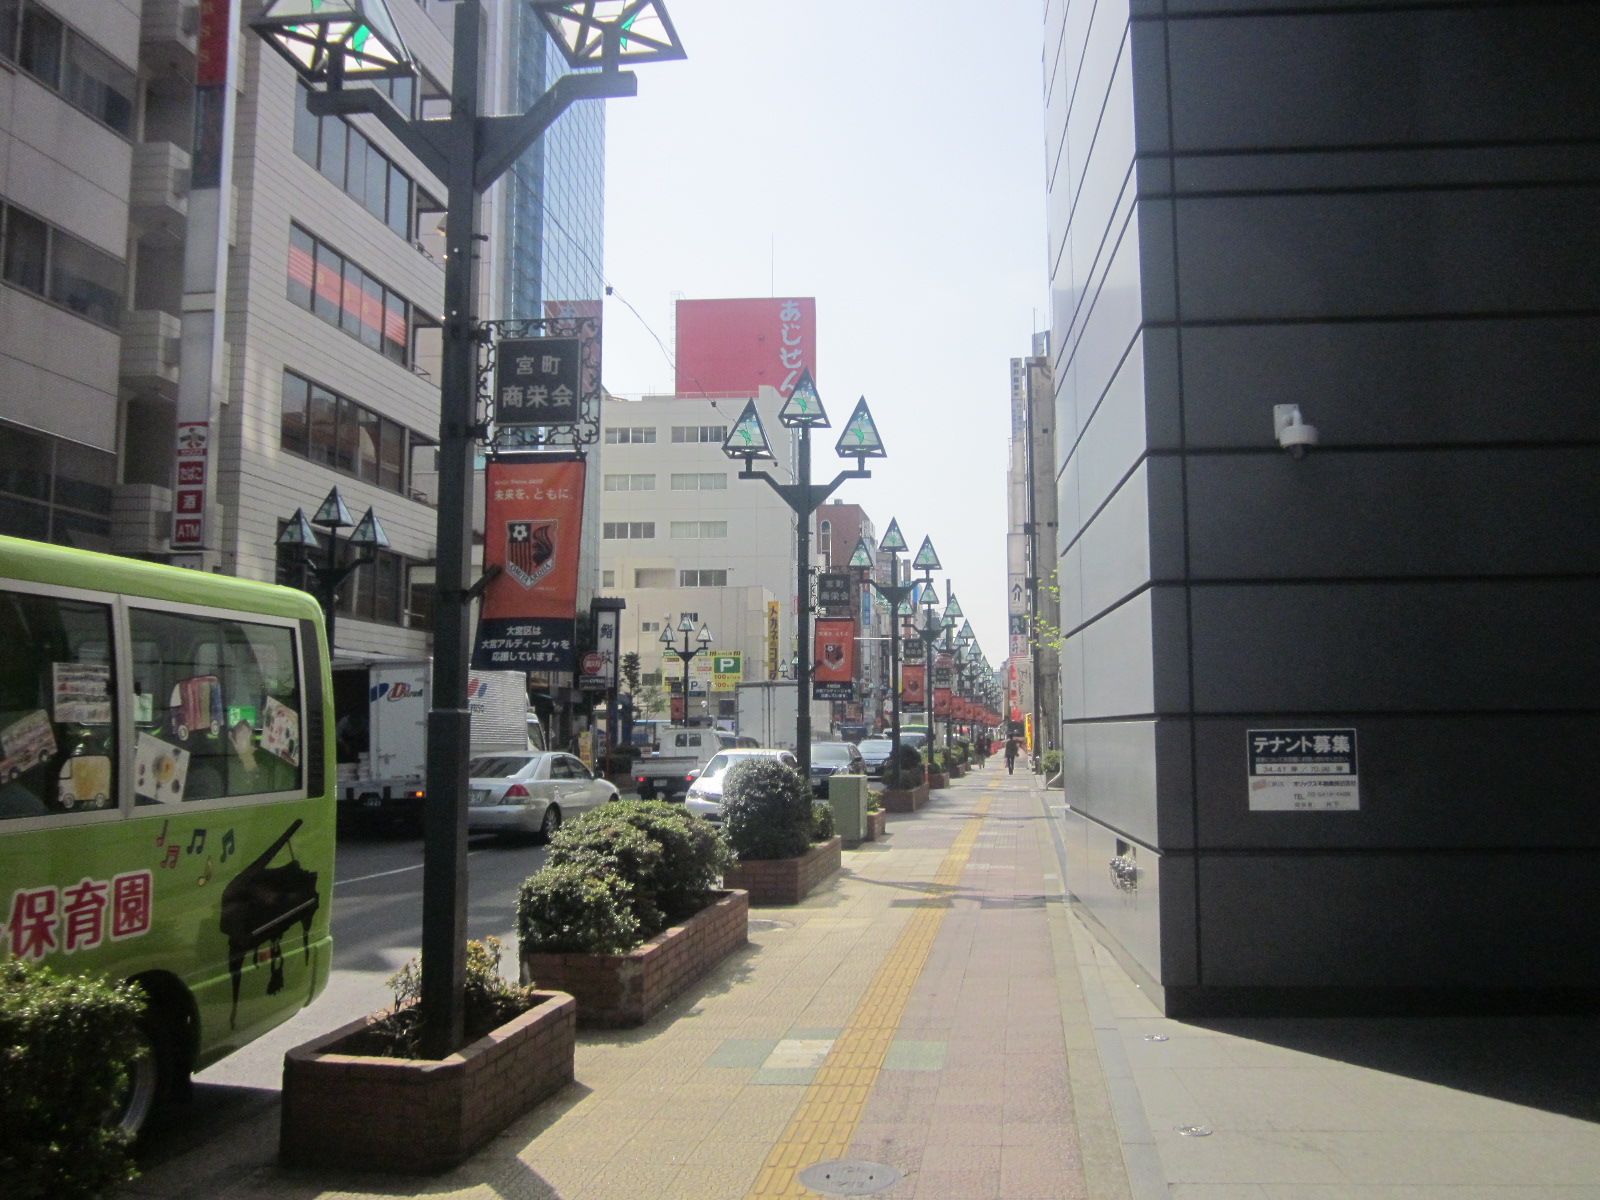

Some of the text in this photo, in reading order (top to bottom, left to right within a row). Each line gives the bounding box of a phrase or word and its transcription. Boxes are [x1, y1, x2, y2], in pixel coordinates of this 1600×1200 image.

[516, 355, 561, 375] 宮町
[502, 384, 573, 408] 商栄会
[177, 523, 199, 538] ATM
[506, 625, 541, 636] 大宮区は
[481, 638, 570, 650] 大宮アルディージャを
[491, 651, 560, 663] 応援しています。
[719, 658, 735, 673] P
[690, 681, 698, 690] P
[1253, 734, 1350, 754] テナント募集
[8, 871, 152, 959] 保育園
